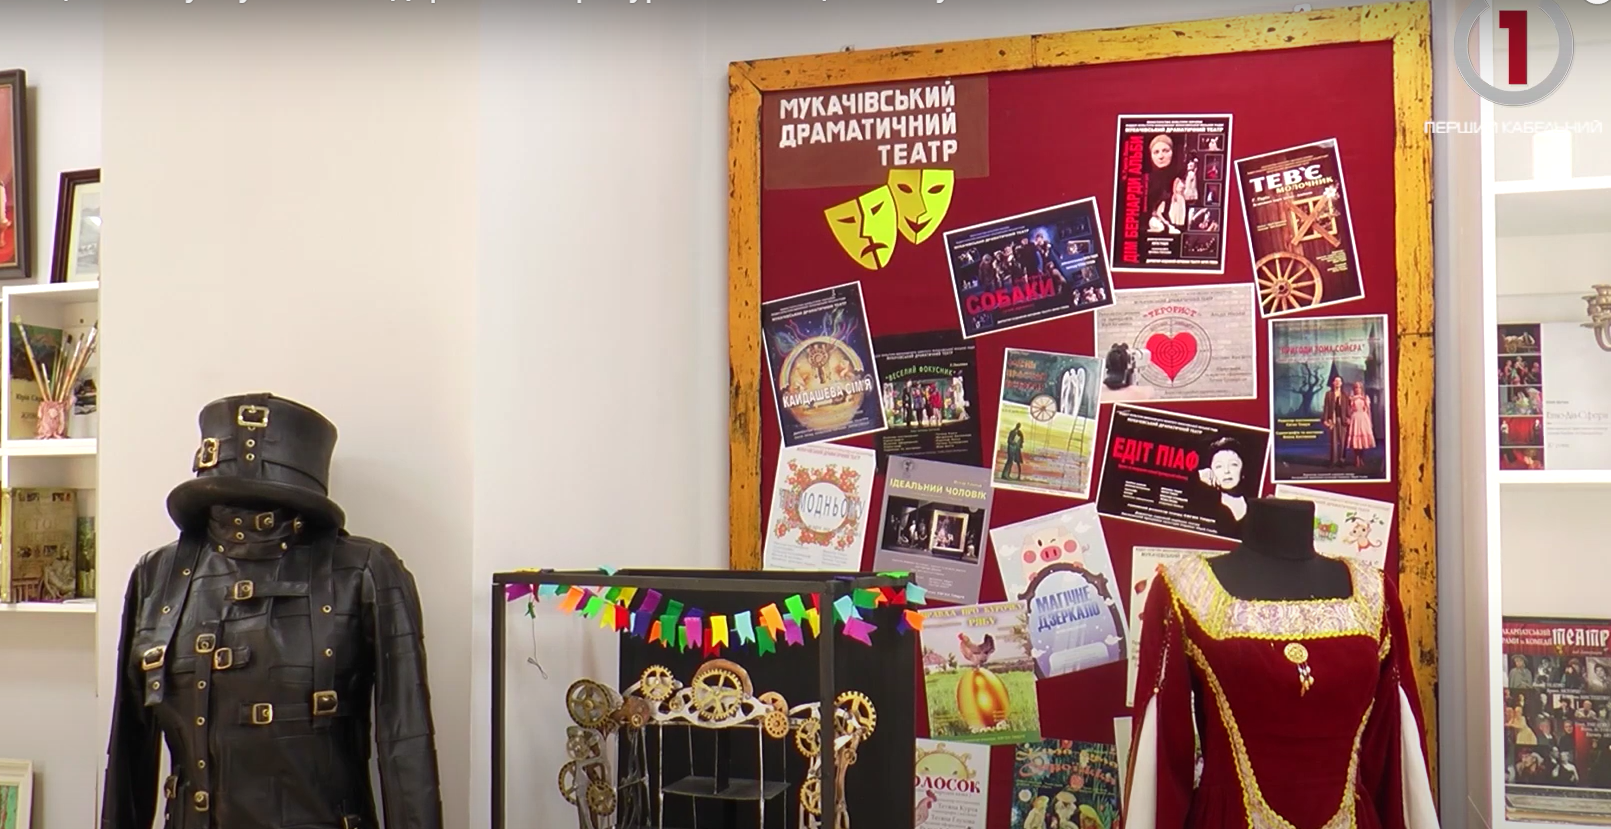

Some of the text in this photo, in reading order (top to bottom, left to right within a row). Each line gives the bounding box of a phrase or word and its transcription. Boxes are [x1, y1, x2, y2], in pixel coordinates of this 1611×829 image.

[779, 80, 956, 120] МУКАЧІВСЬКИЙ
[779, 107, 957, 149] ДРАМАТИЧНИЙ
[878, 139, 958, 166] ТЕАТР
[1123, 135, 1145, 264] ДІМ БЕРНАРДИ АЛЬБИ
[1275, 176, 1334, 194] МОЛОЧНИК
[965, 278, 1056, 315] СОБАКИ
[1112, 436, 1199, 472] ЕДІТ ПІАФ
[946, 486, 987, 500] ЧОЛОВІК
[1035, 585, 1090, 613] МАГІЧНЕ
[1037, 604, 1101, 632] ДЗЕРКАЛО
